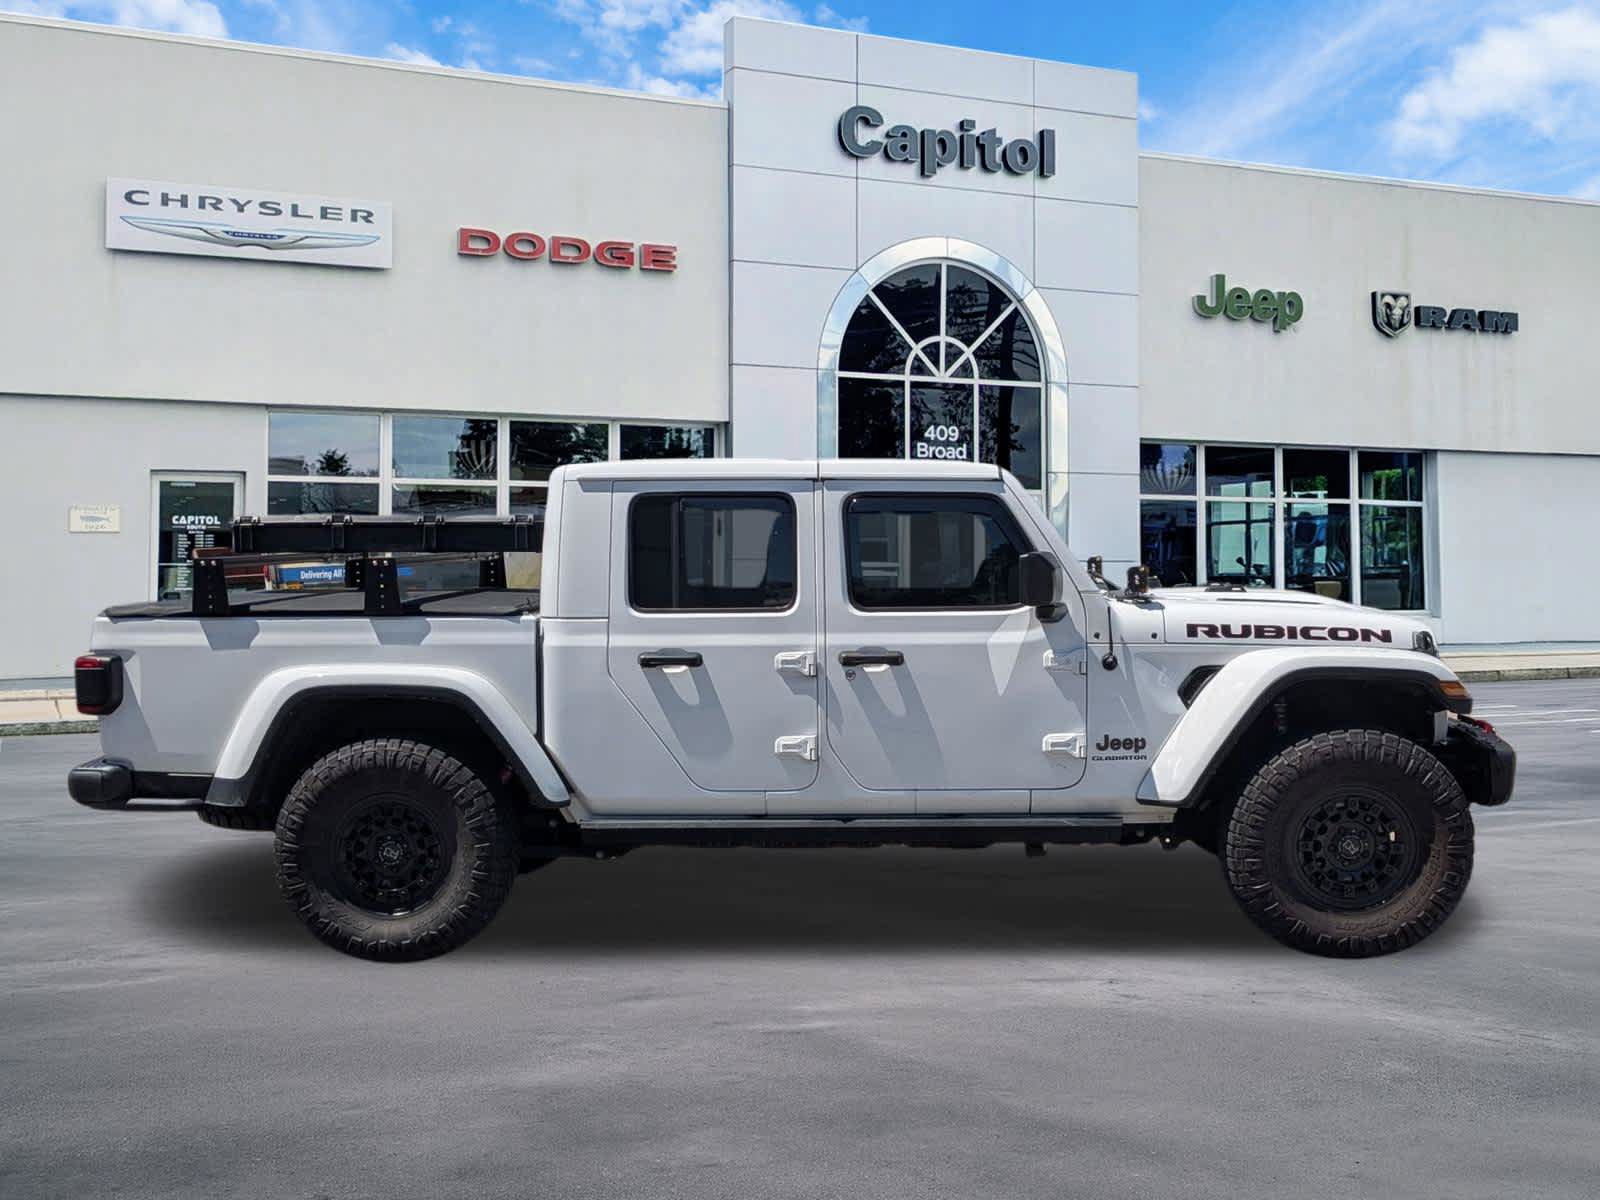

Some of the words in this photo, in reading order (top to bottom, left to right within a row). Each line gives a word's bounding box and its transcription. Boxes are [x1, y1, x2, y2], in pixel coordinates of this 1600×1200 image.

[837, 105, 1056, 177] Capitol
[123, 189, 375, 224] CHRYSLER
[457, 227, 678, 272] DODGE
[1192, 274, 1303, 333] Jeep
[1414, 305, 1519, 334] RAM
[924, 425, 959, 441] 409
[917, 442, 967, 459] Broad
[171, 515, 221, 525] CAPITOL
[300, 569, 332, 580] Delivering
[1186, 623, 1392, 643] RUBICON
[1096, 734, 1146, 753] Jeep
